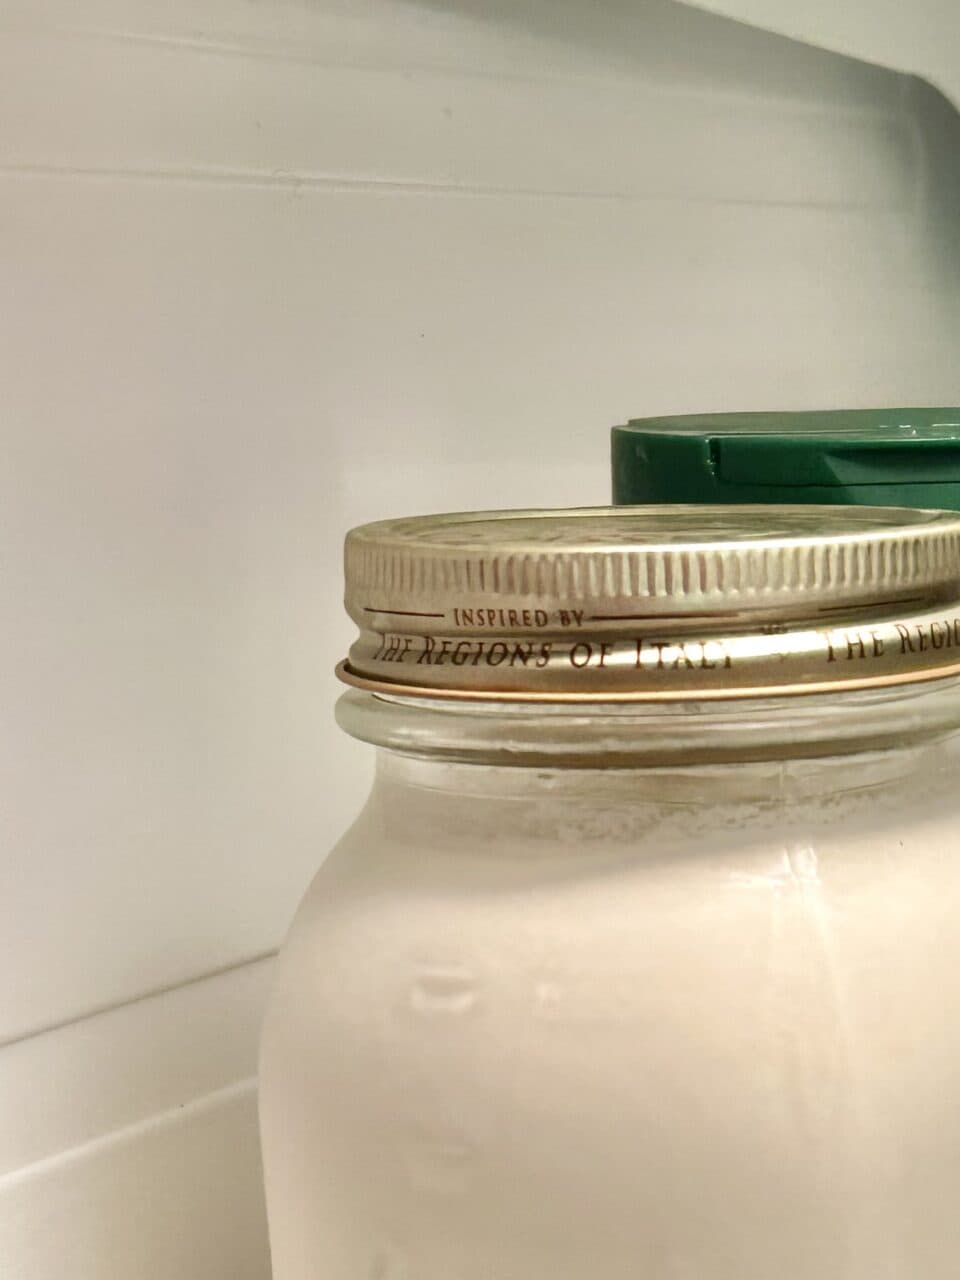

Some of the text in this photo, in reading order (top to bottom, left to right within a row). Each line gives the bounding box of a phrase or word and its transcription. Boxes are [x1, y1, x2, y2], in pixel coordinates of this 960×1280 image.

[453, 608, 584, 628] INSPIRED BY
[372, 632, 413, 663] THE
[417, 635, 553, 667] REGIONS
[818, 628, 884, 664] THE
